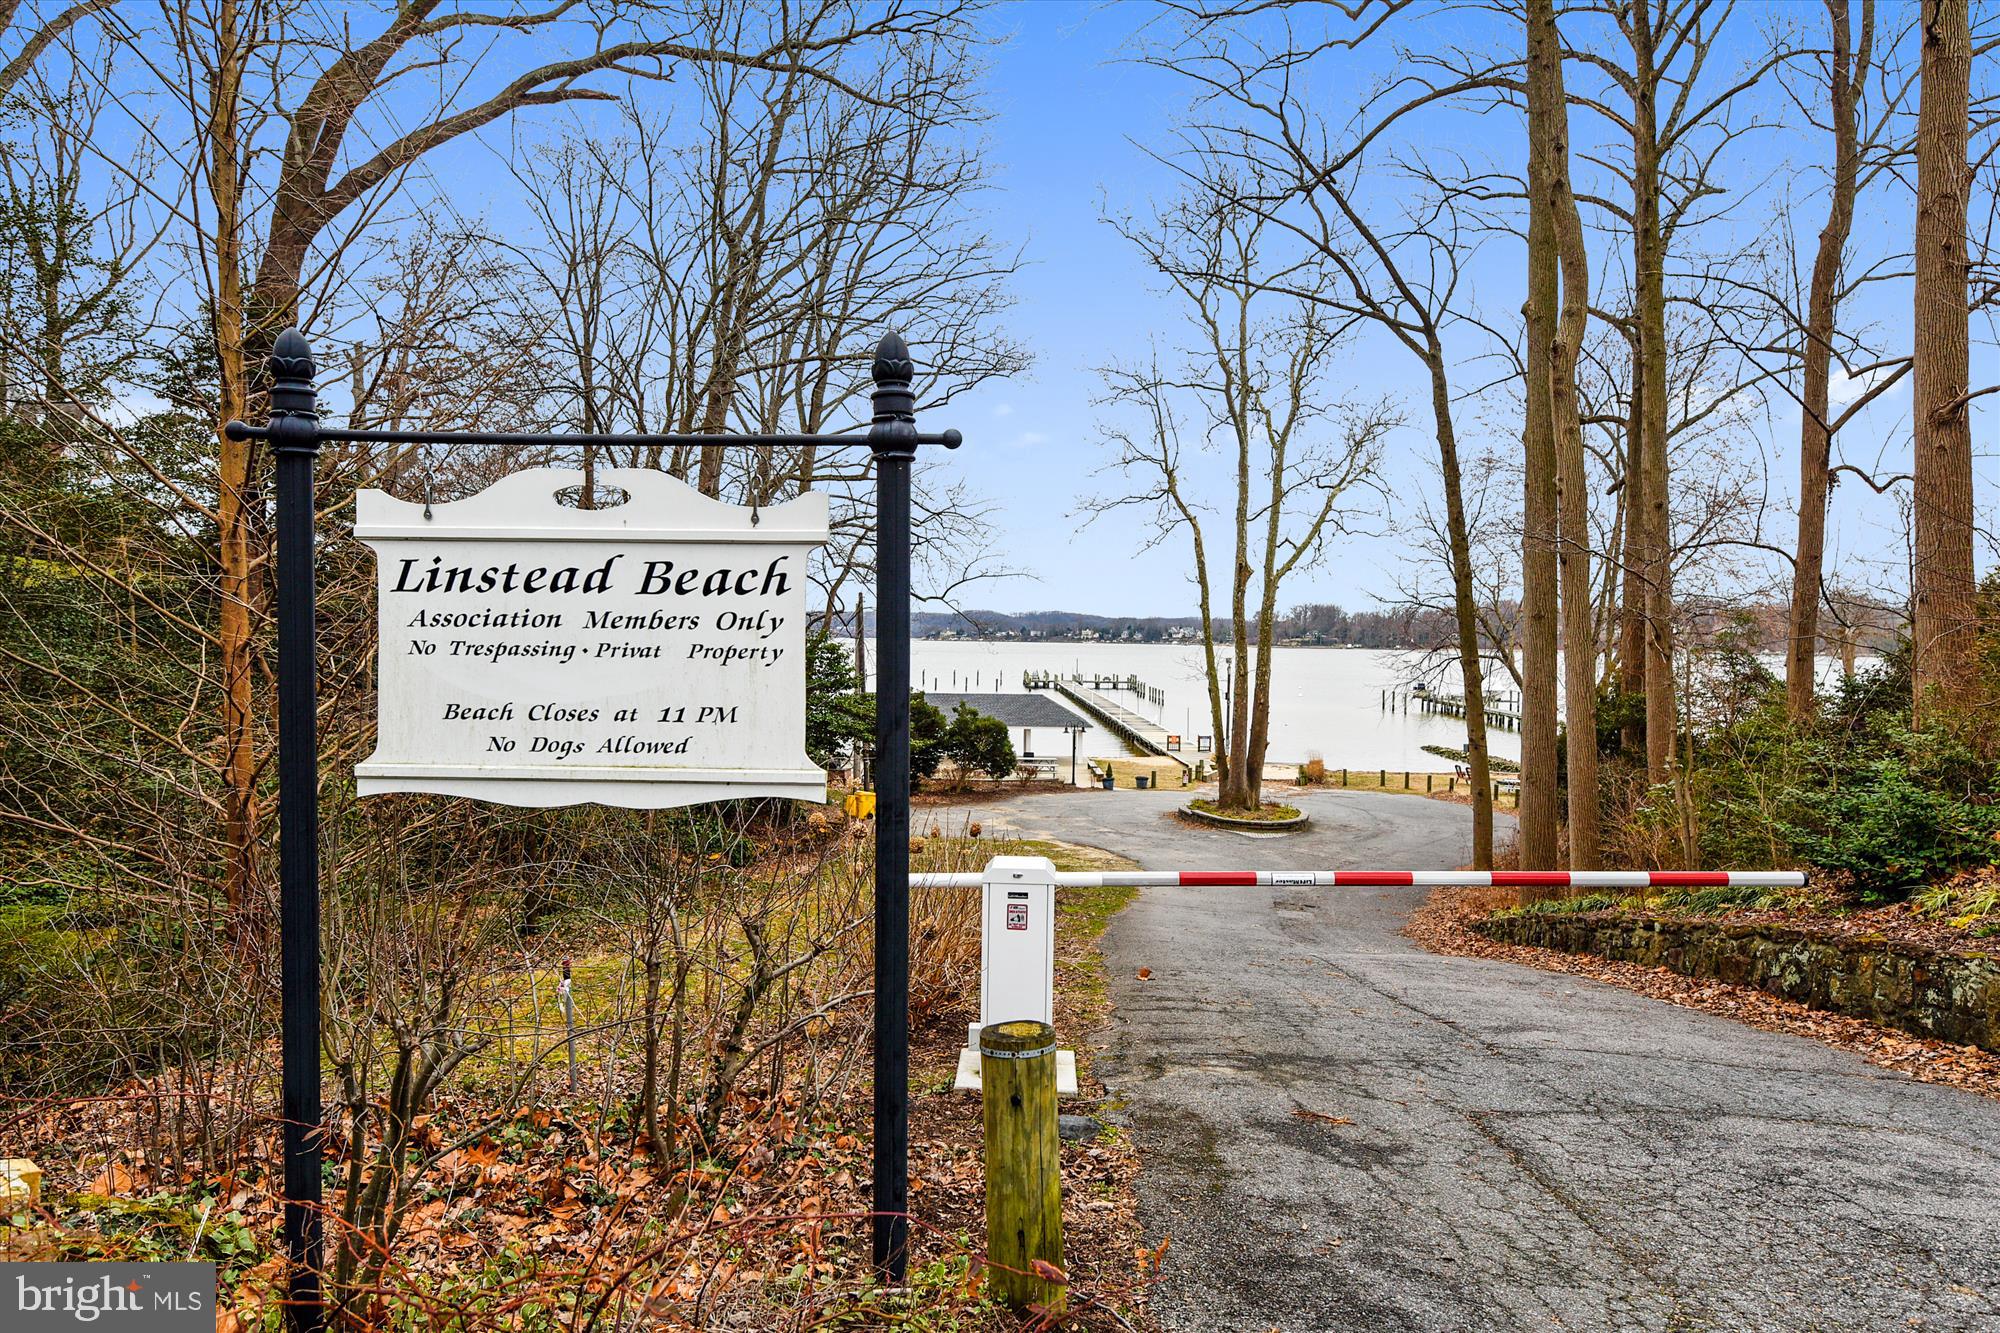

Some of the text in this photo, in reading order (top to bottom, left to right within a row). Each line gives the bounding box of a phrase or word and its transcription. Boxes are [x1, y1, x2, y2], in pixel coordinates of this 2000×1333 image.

[390, 554, 791, 597] Linstead Beach
[407, 608, 784, 638] Association Members Only
[408, 640, 784, 667] No Trespassing Privat Property
[443, 702, 738, 724] Beach Closes at 11 PM
[486, 736, 693, 760] No Dogs Allowed
